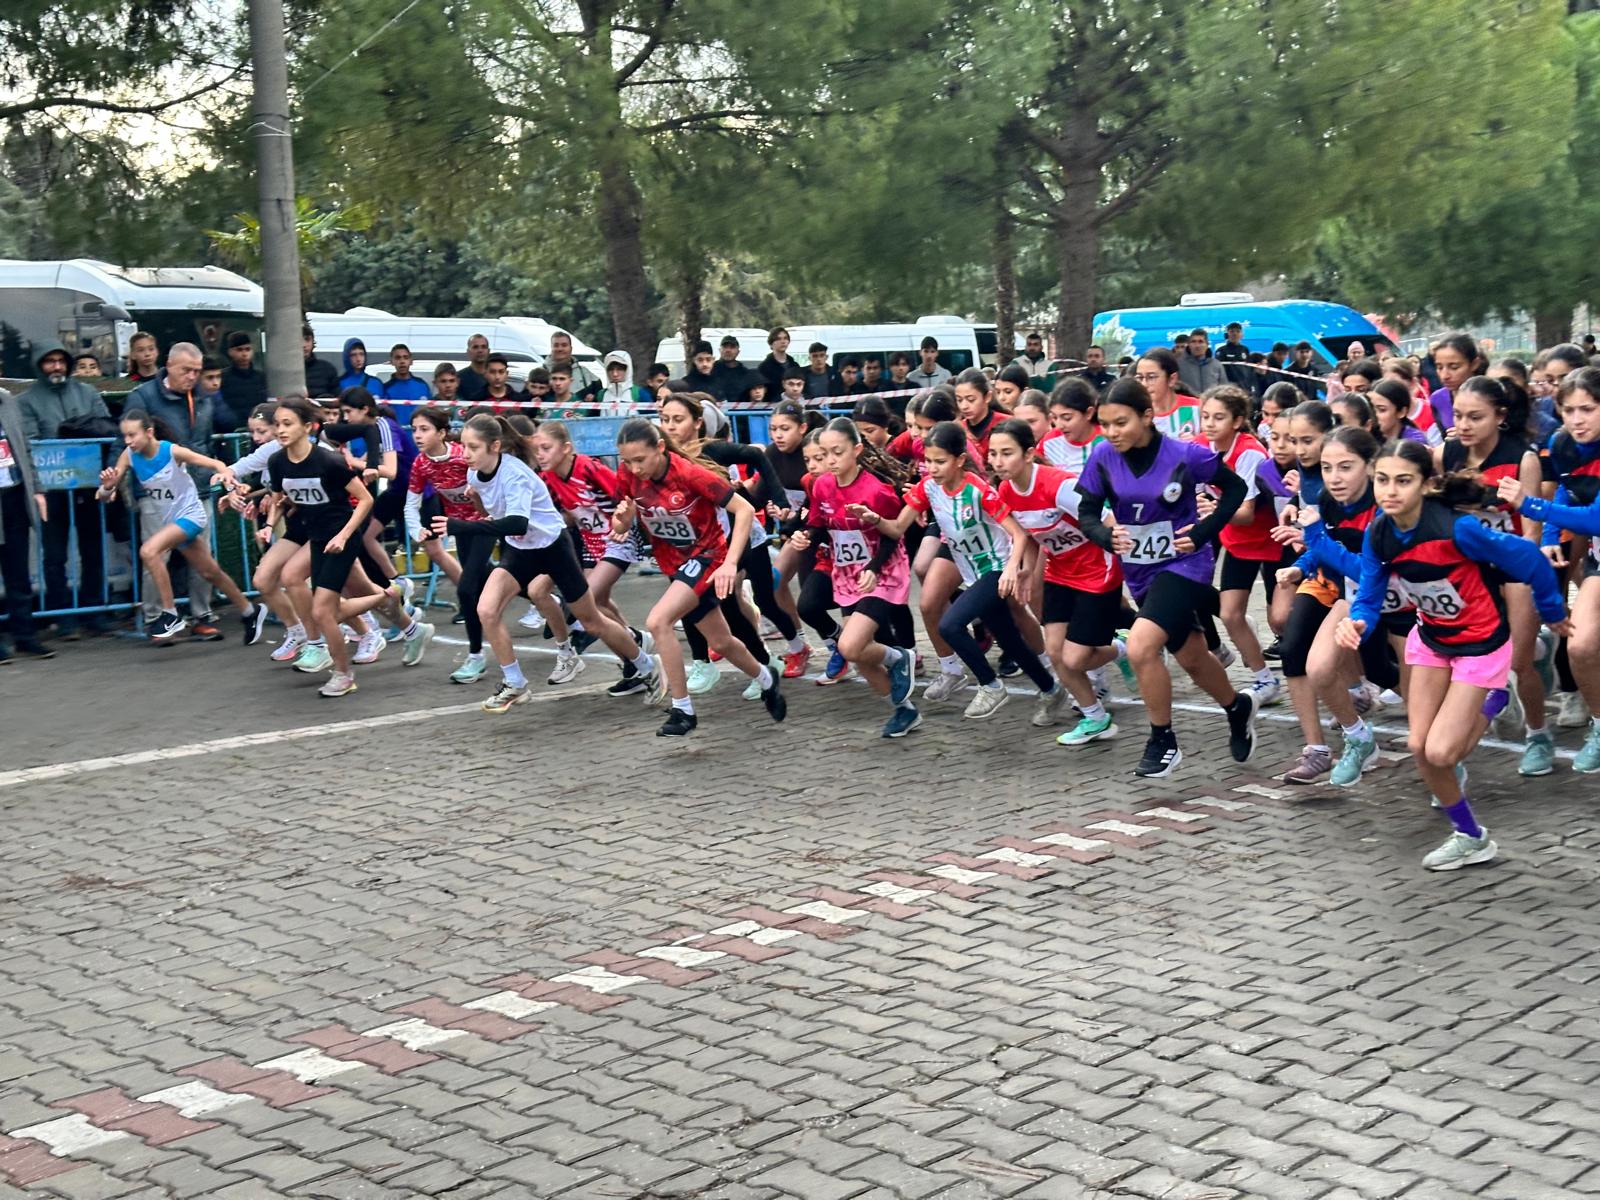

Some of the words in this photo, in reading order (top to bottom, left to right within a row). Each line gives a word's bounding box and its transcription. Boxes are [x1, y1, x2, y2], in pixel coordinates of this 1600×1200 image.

[289, 488, 323, 503] 270
[1132, 503, 1144, 522] 7
[650, 521, 691, 538] 258
[1043, 530, 1083, 551] 246
[1129, 535, 1172, 560] 242
